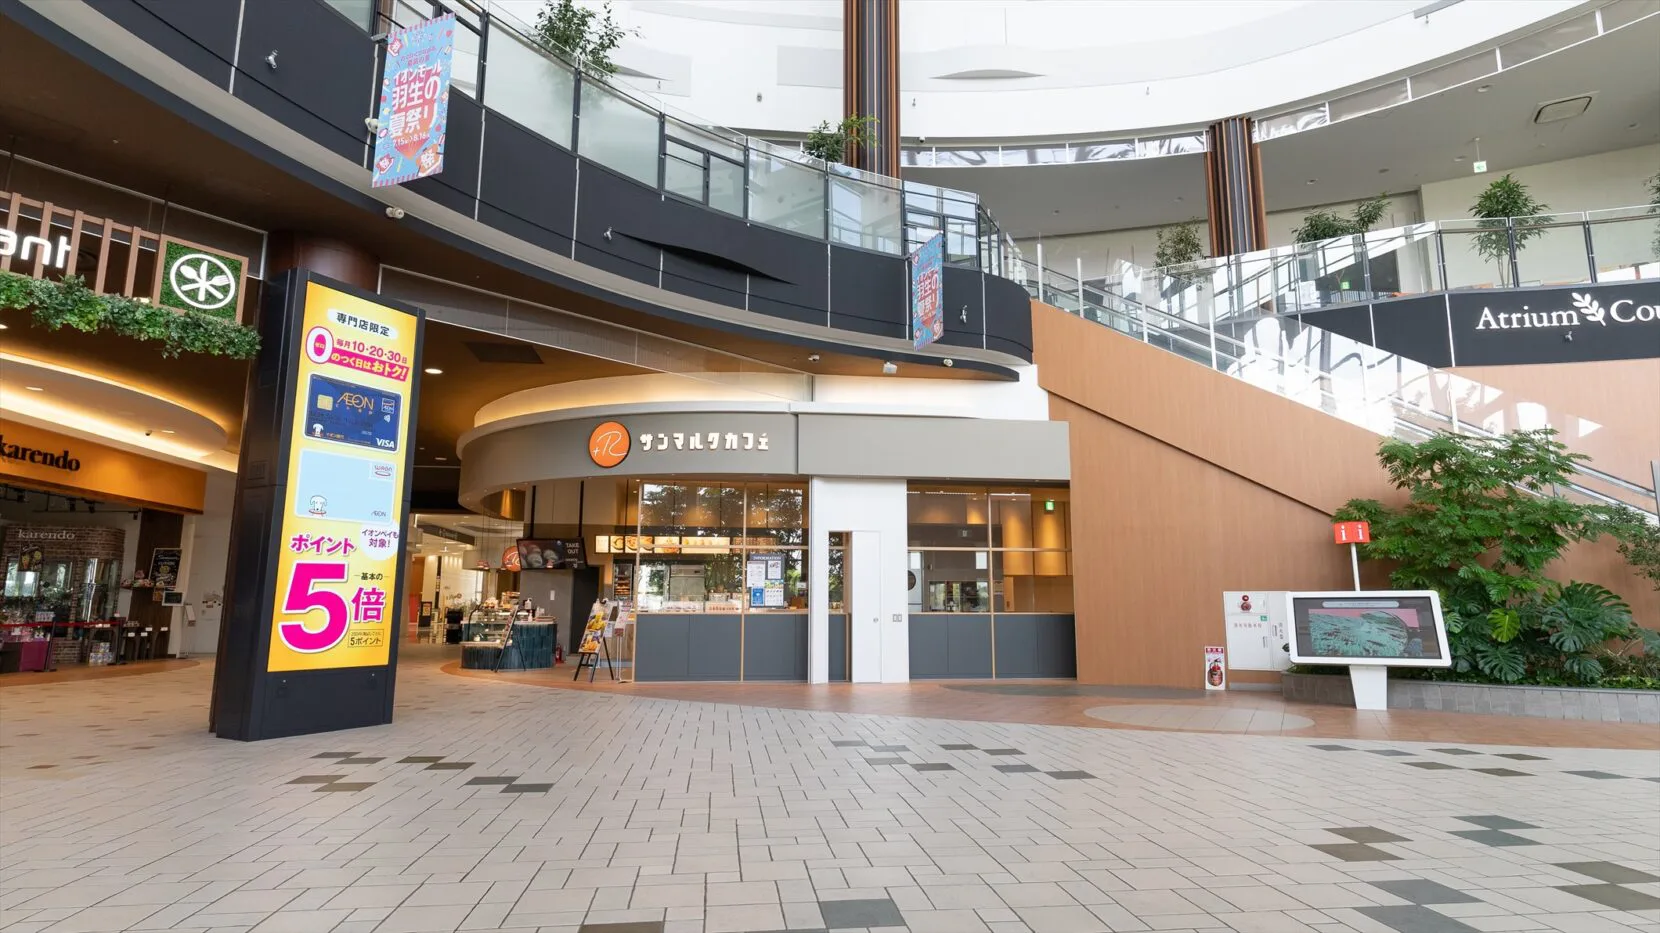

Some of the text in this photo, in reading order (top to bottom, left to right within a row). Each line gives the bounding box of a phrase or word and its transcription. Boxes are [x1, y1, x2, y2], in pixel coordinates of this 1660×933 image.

[393, 60, 442, 86] イオンモール
[392, 75, 441, 110] 羽生の
[389, 102, 438, 138] 夏祭り
[336, 312, 390, 337] 専門店限定
[1475, 305, 1581, 330] Atrium
[0, 434, 81, 472] karendo
[375, 437, 395, 449] VISA
[639, 432, 769, 451] サンマルクカフェ
[17, 528, 75, 540] karendo
[290, 533, 355, 555] ポイント
[368, 537, 391, 549] 対象!
[360, 572, 384, 581] 基本の
[280, 562, 349, 652] 5
[350, 586, 385, 622] 倍
[350, 636, 382, 646] 5ポイント
